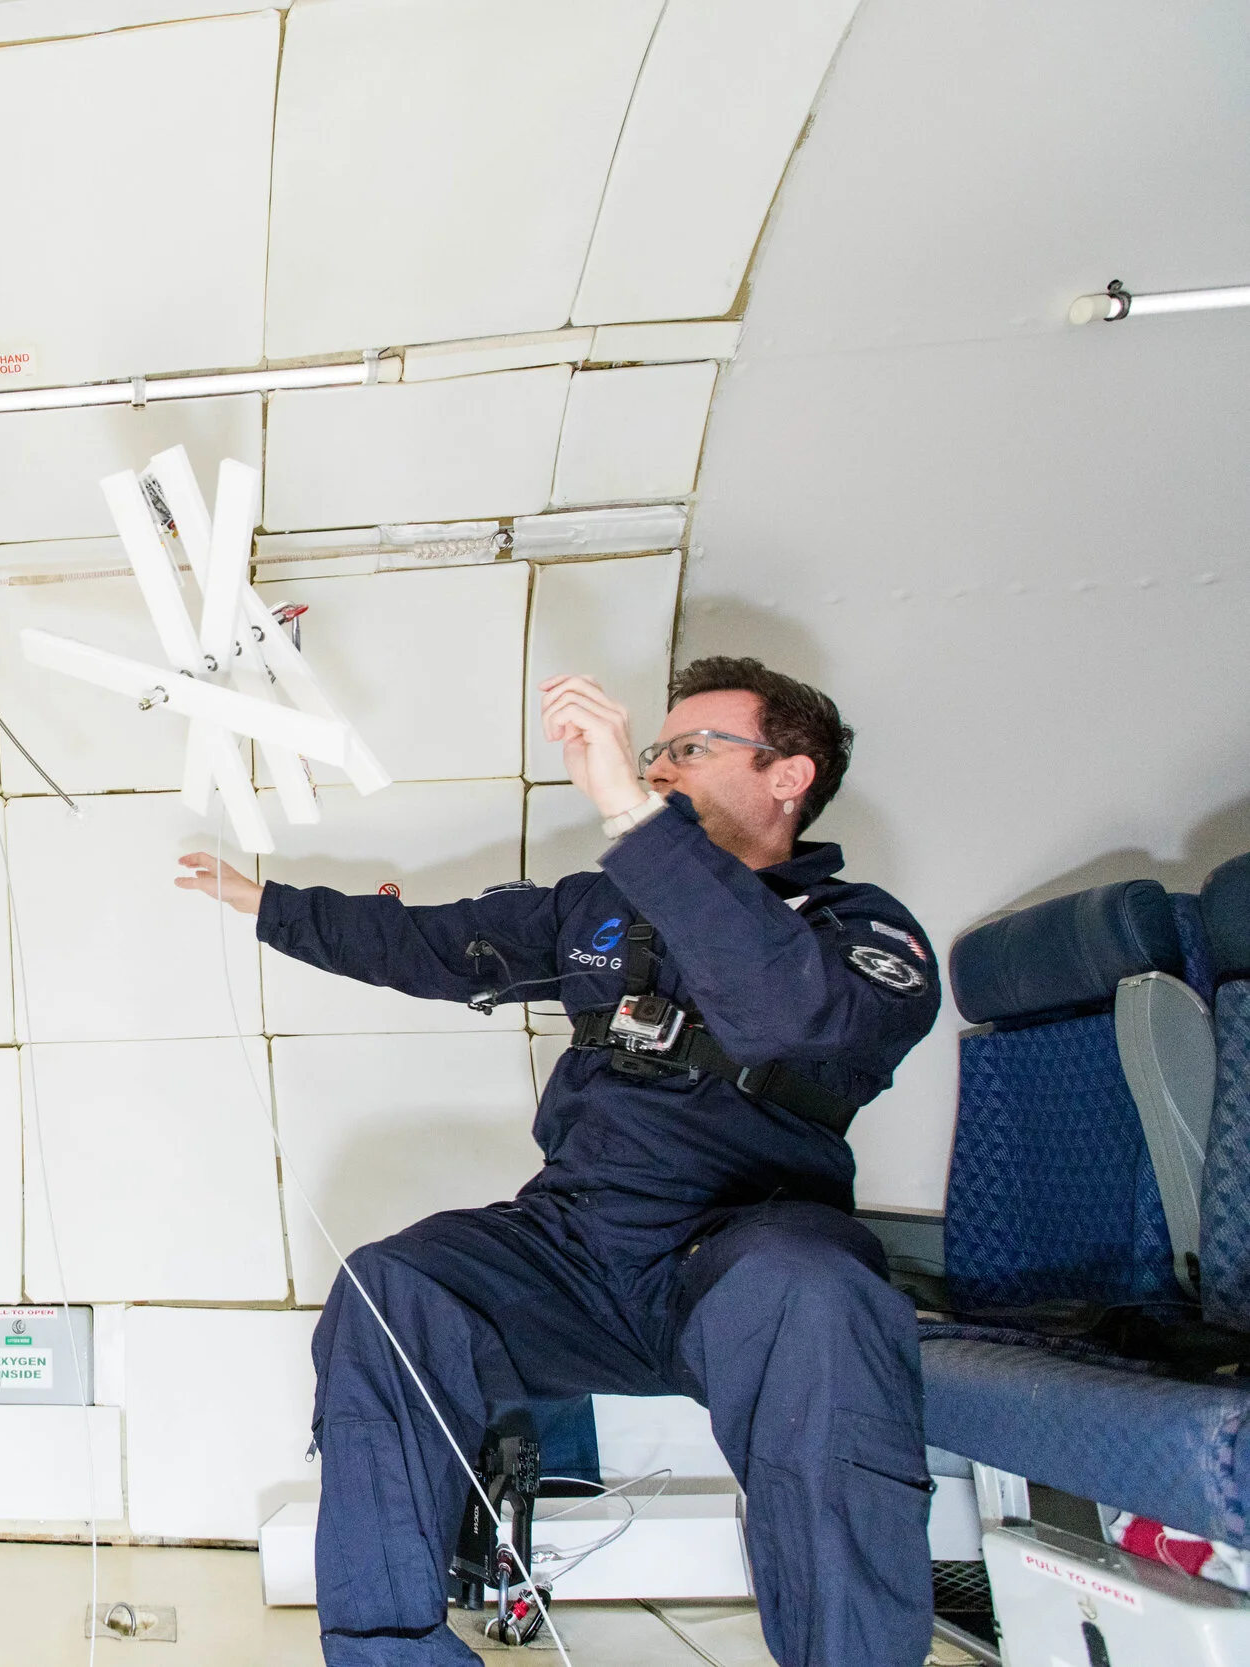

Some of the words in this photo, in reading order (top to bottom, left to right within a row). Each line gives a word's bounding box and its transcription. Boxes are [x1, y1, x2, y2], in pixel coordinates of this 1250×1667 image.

[0, 353, 30, 365] HAND
[610, 957, 623, 970] G
[1025, 1556, 1062, 1577] PULL
[1067, 1571, 1086, 1585] TO
[1091, 1581, 1135, 1604] OPEN
